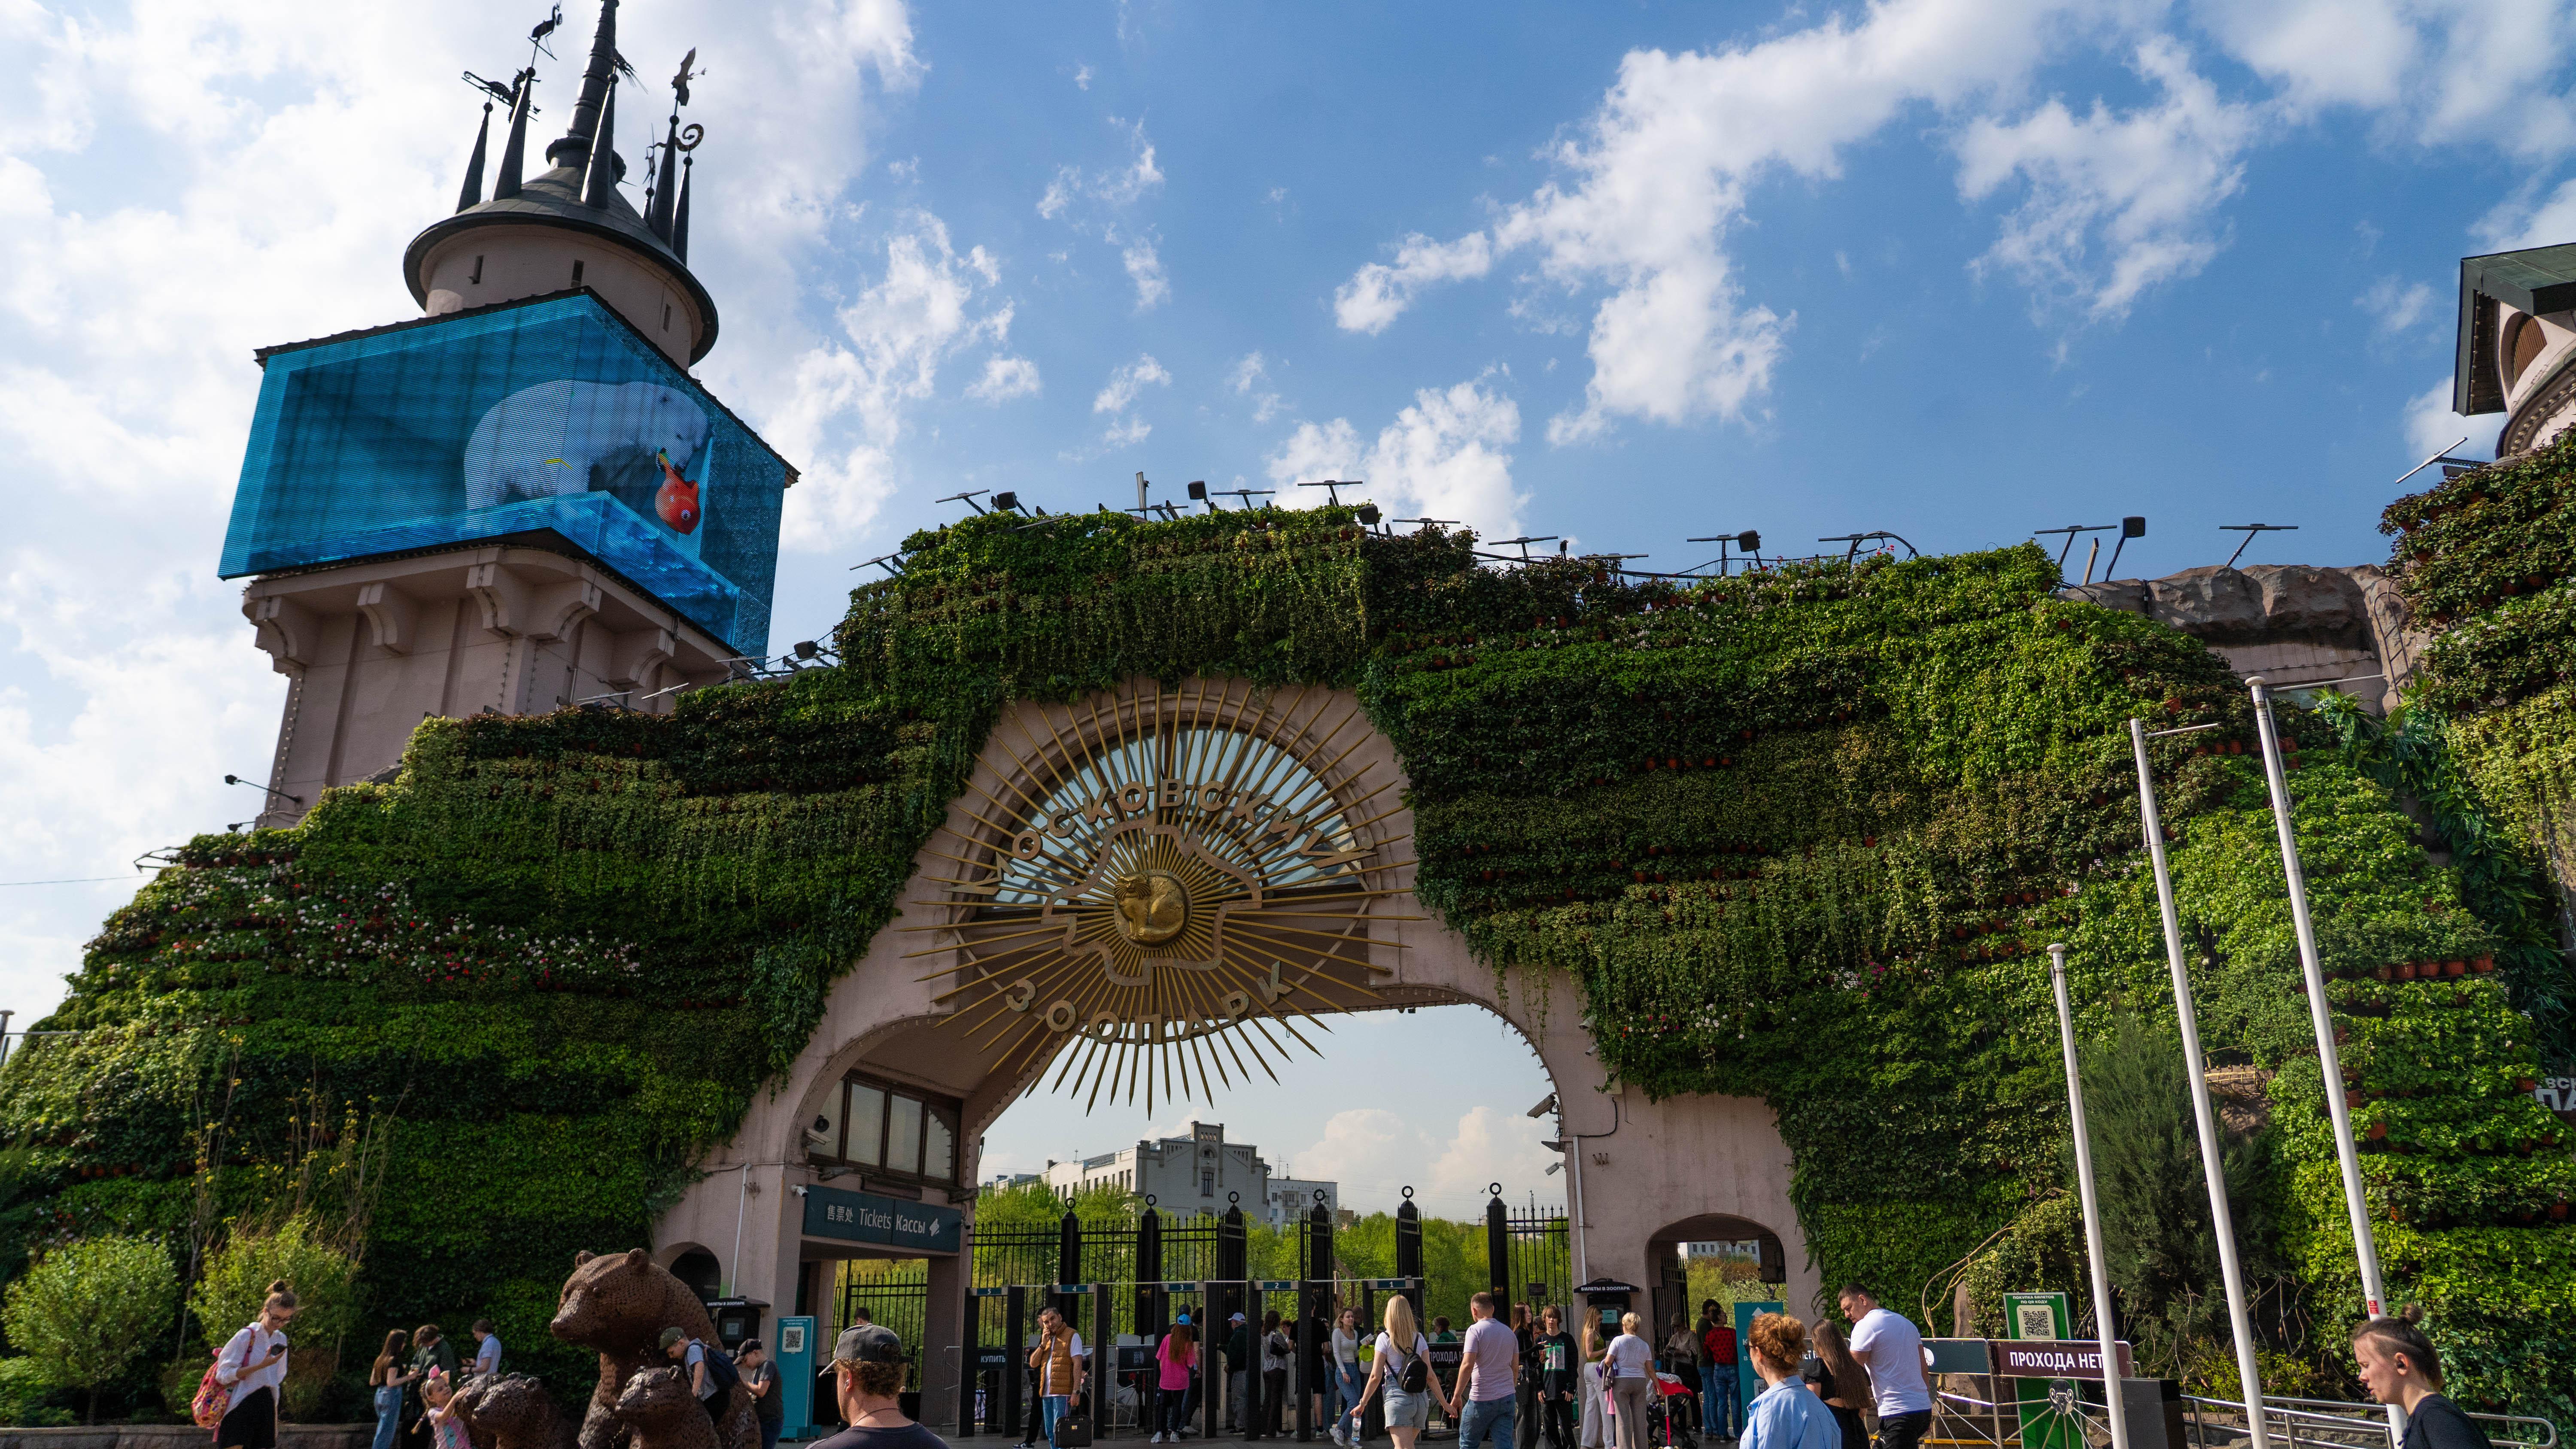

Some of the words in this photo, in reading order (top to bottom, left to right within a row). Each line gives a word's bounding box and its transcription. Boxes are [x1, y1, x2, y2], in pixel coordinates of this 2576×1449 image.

[945, 778, 1377, 896] МОСКОВСКИЙ
[1005, 960, 1293, 1046] ЗООПАРК
[827, 1204, 854, 1223] 售票处
[860, 1208, 892, 1229] Tickets
[896, 1214, 926, 1234] Кассы
[1429, 1351, 1458, 1364] ПРОХОДА
[2010, 1352, 2076, 1371] ПРОХОДА
[2078, 1353, 2102, 1368] НЕТ
